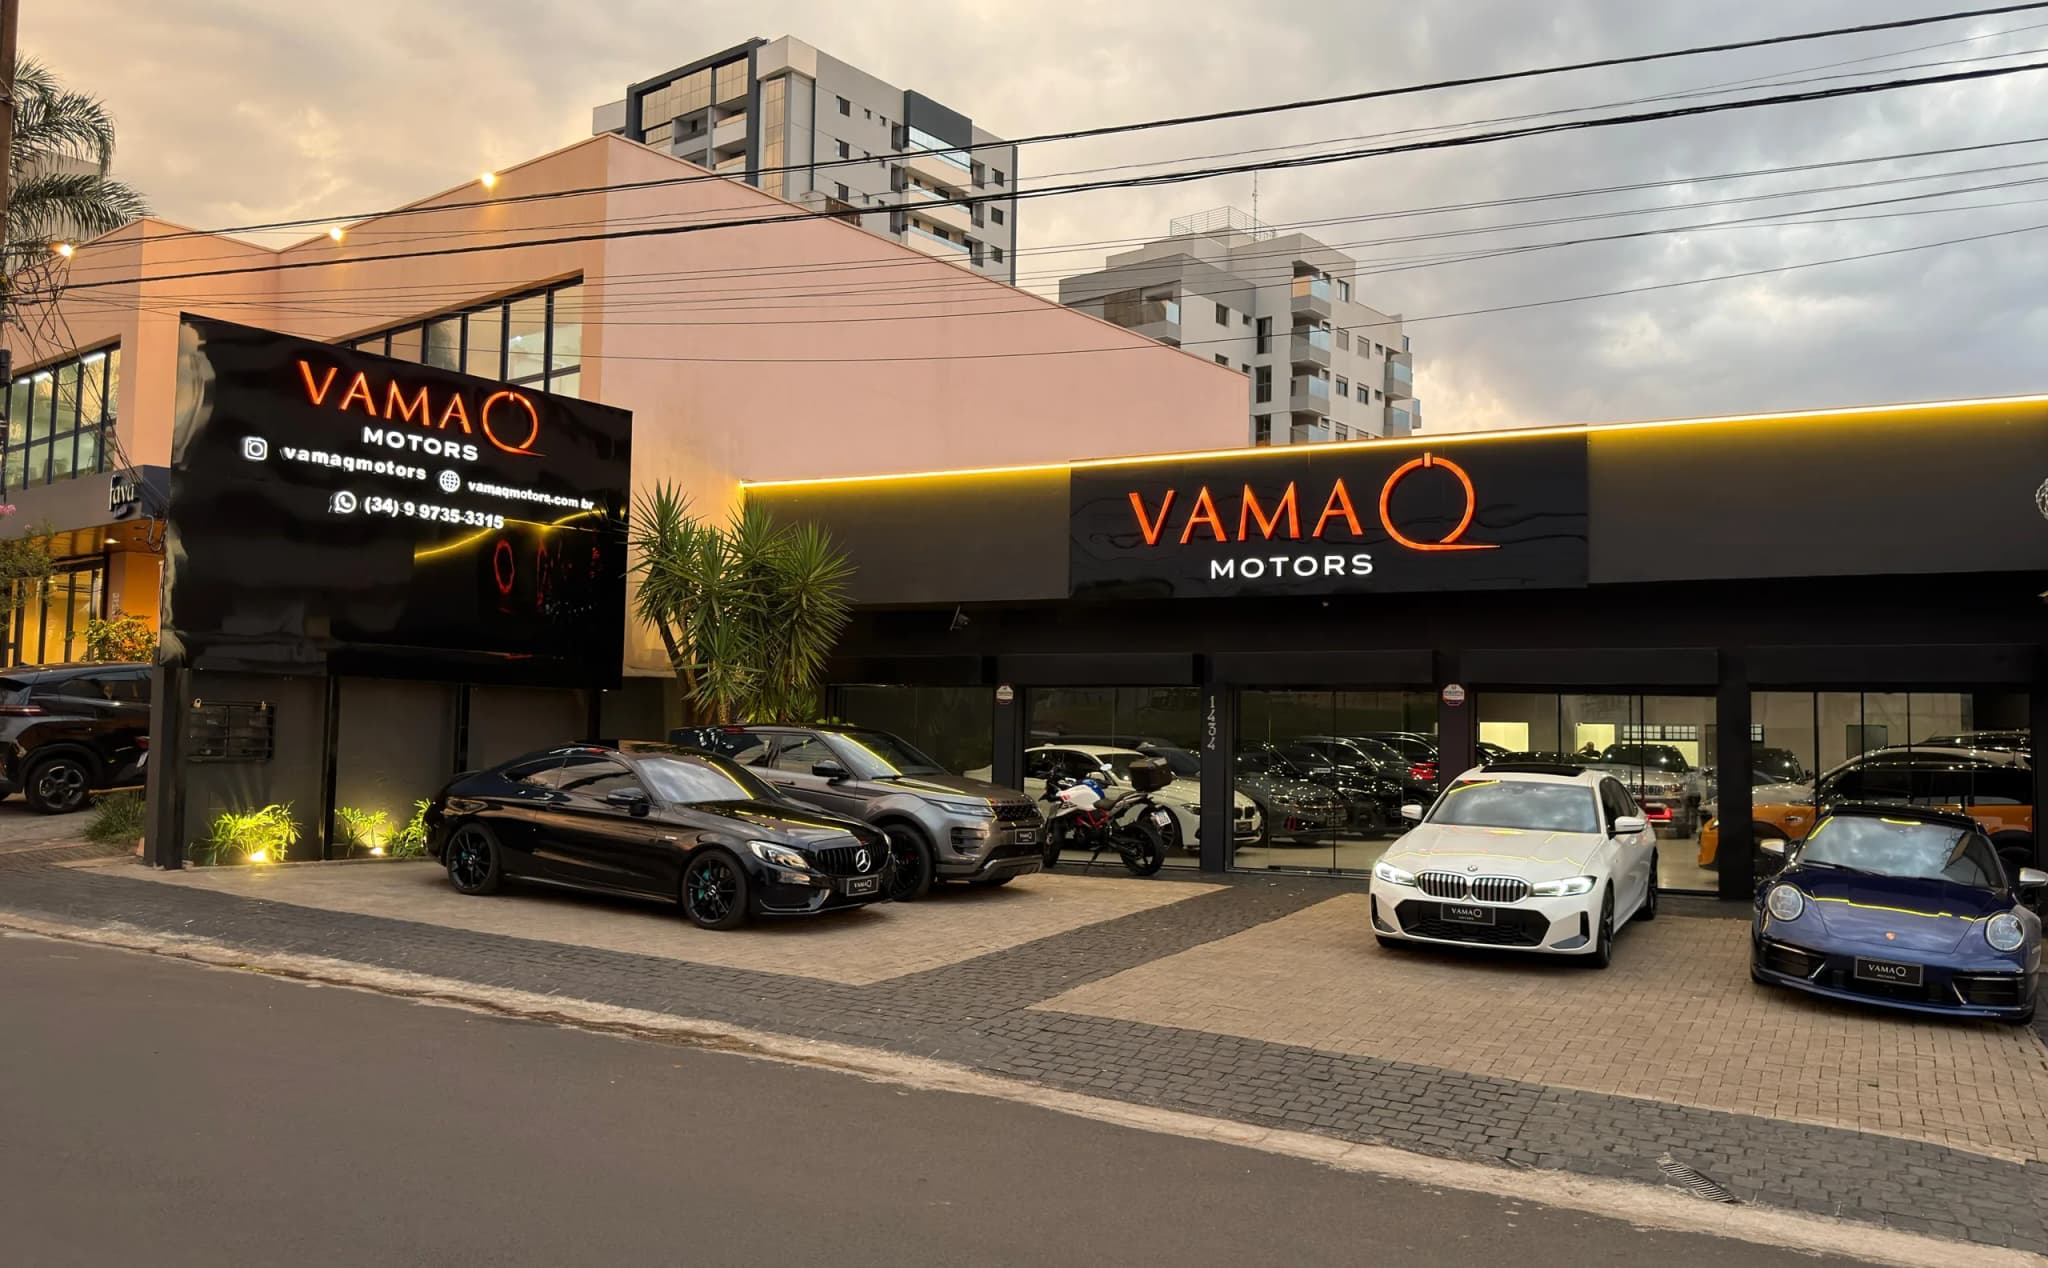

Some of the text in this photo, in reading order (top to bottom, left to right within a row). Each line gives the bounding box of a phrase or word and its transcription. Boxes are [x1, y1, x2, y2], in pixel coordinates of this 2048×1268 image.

[297, 360, 546, 456] VAMAQ
[363, 426, 479, 461] MOTORS
[283, 447, 427, 480] vamaqmotors
[364, 497, 504, 529] (34) 9 9735-3315
[1129, 452, 1501, 551] VAMAQ
[1210, 553, 1374, 580] MOTORS
[1451, 907, 1482, 918] VAMAQ
[1868, 964, 1907, 977] VAMAQ
